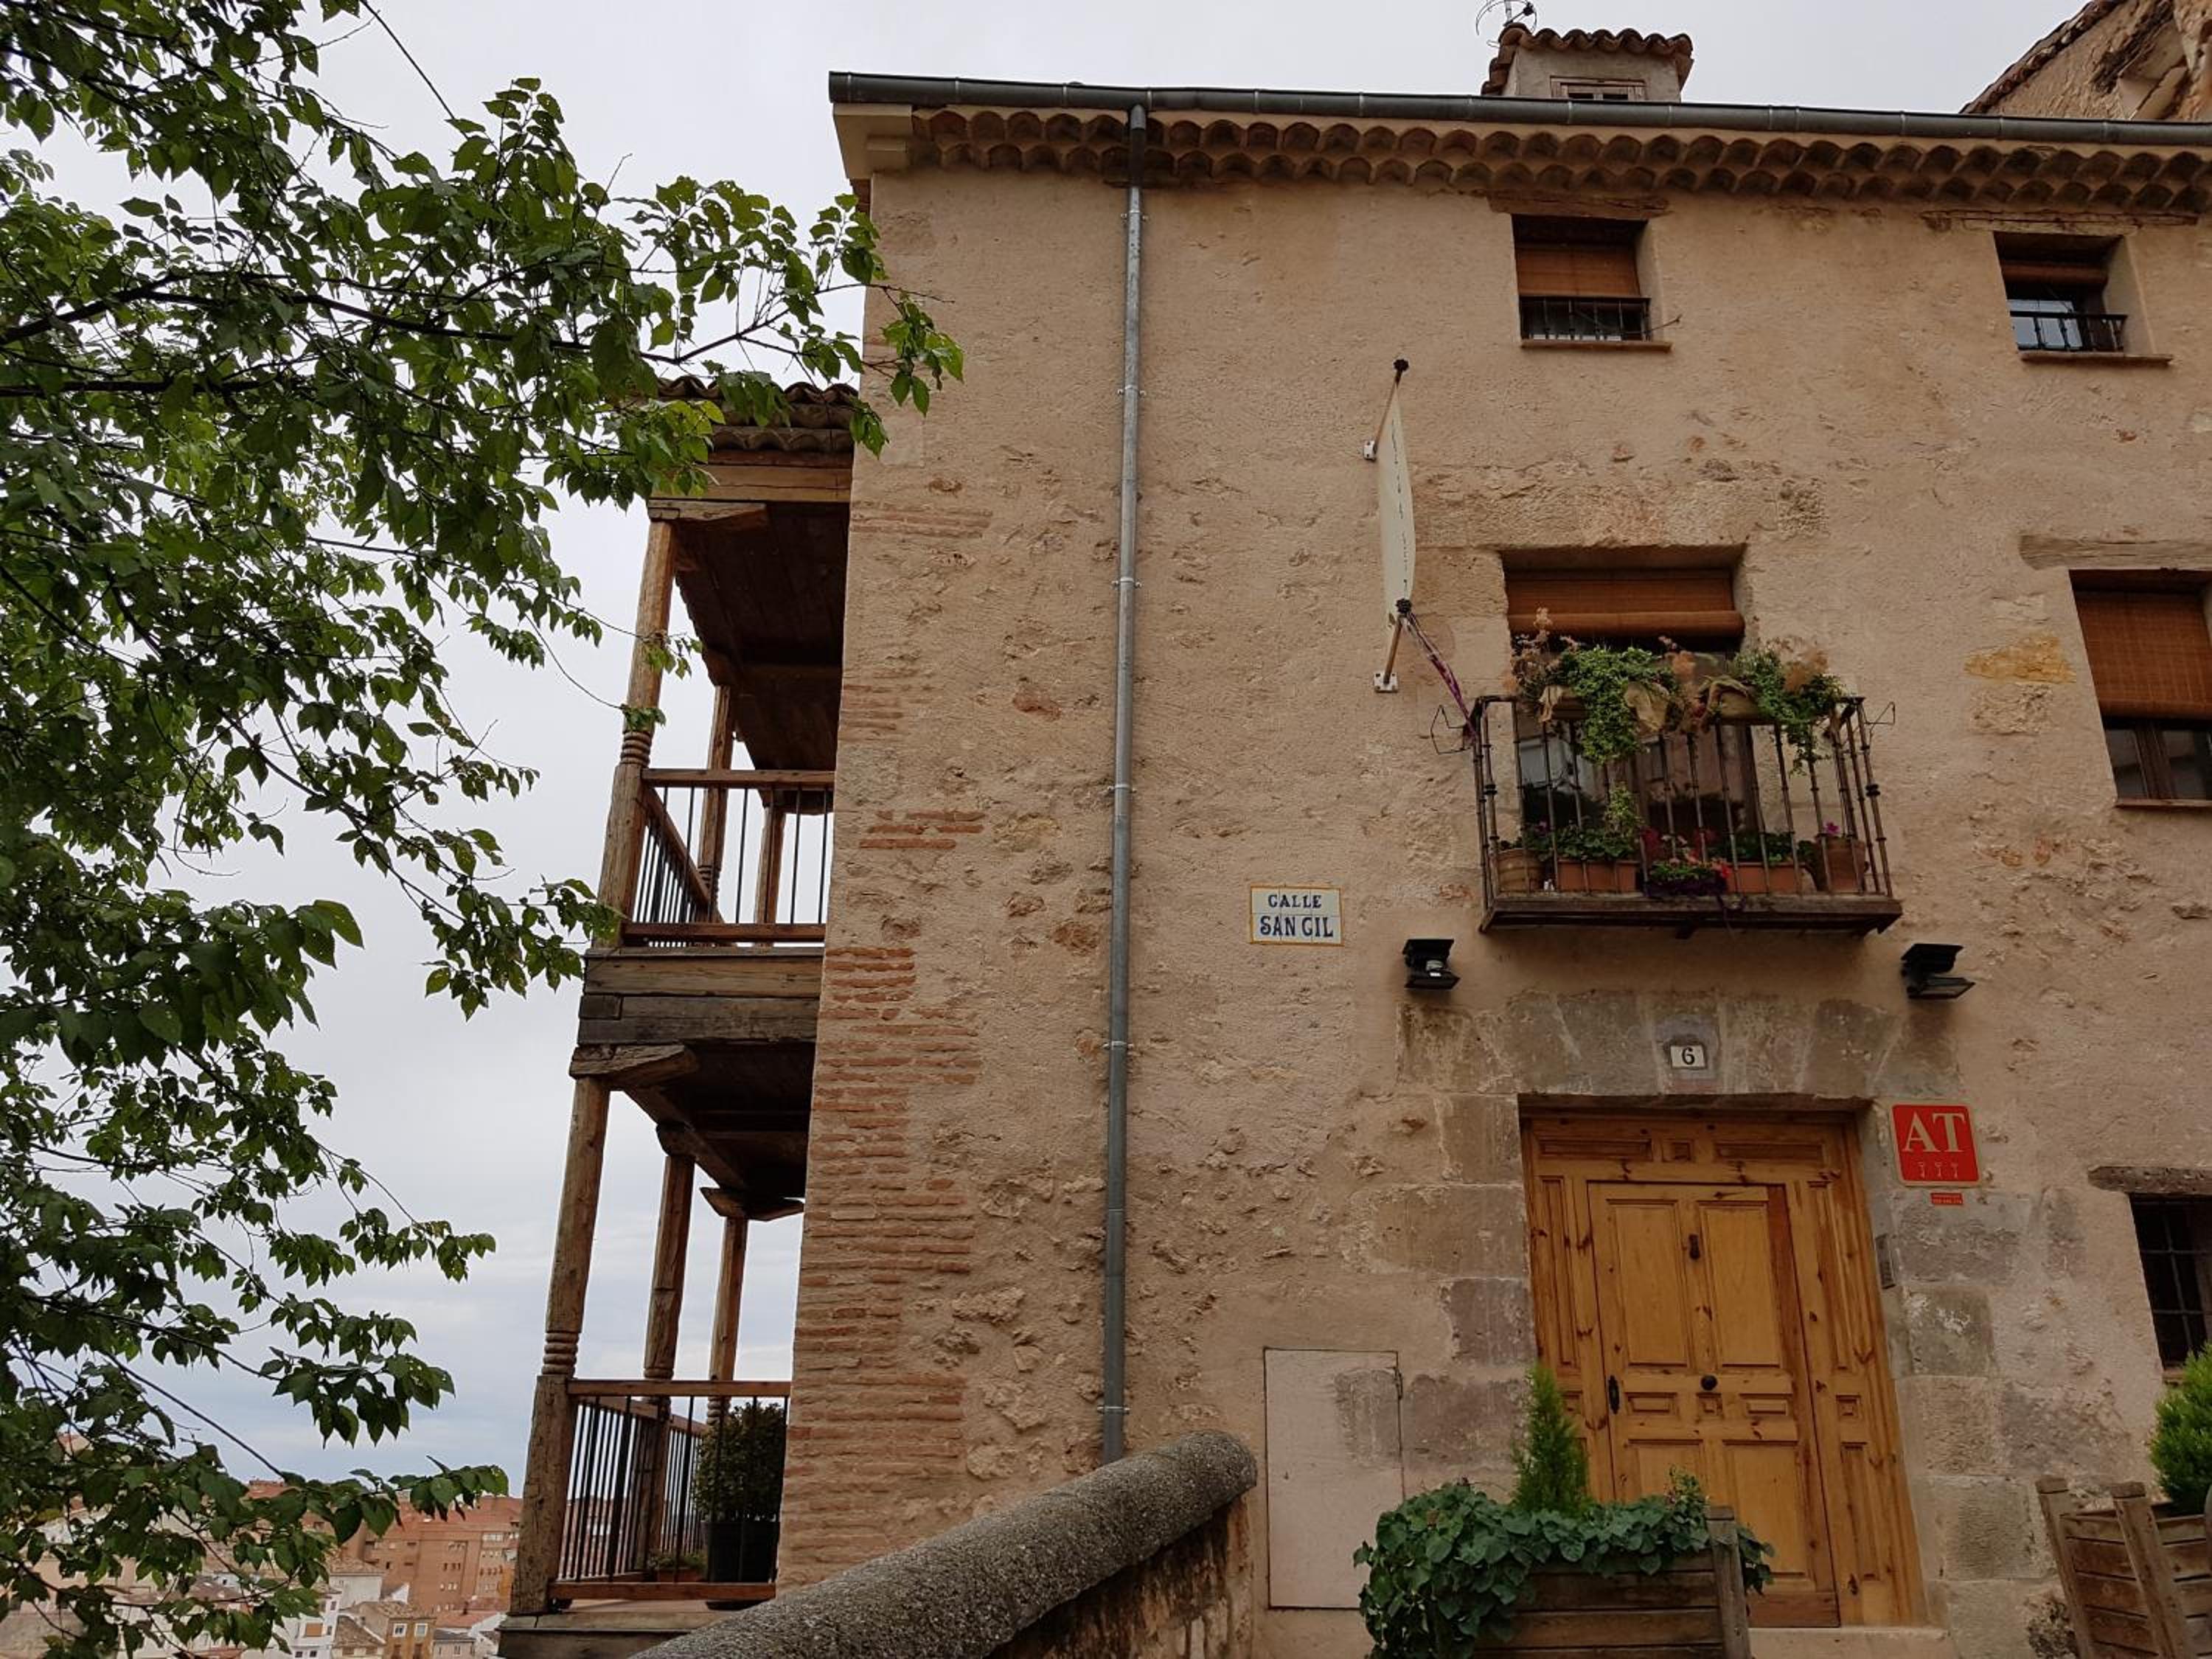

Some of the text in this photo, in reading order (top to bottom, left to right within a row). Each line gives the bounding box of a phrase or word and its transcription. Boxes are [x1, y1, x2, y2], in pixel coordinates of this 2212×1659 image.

[1267, 894, 1322, 908] CALLE
[1259, 915, 1334, 937] SAN GIL
[1682, 1047, 1695, 1065] 6
[1901, 1111, 1965, 1152] AT
